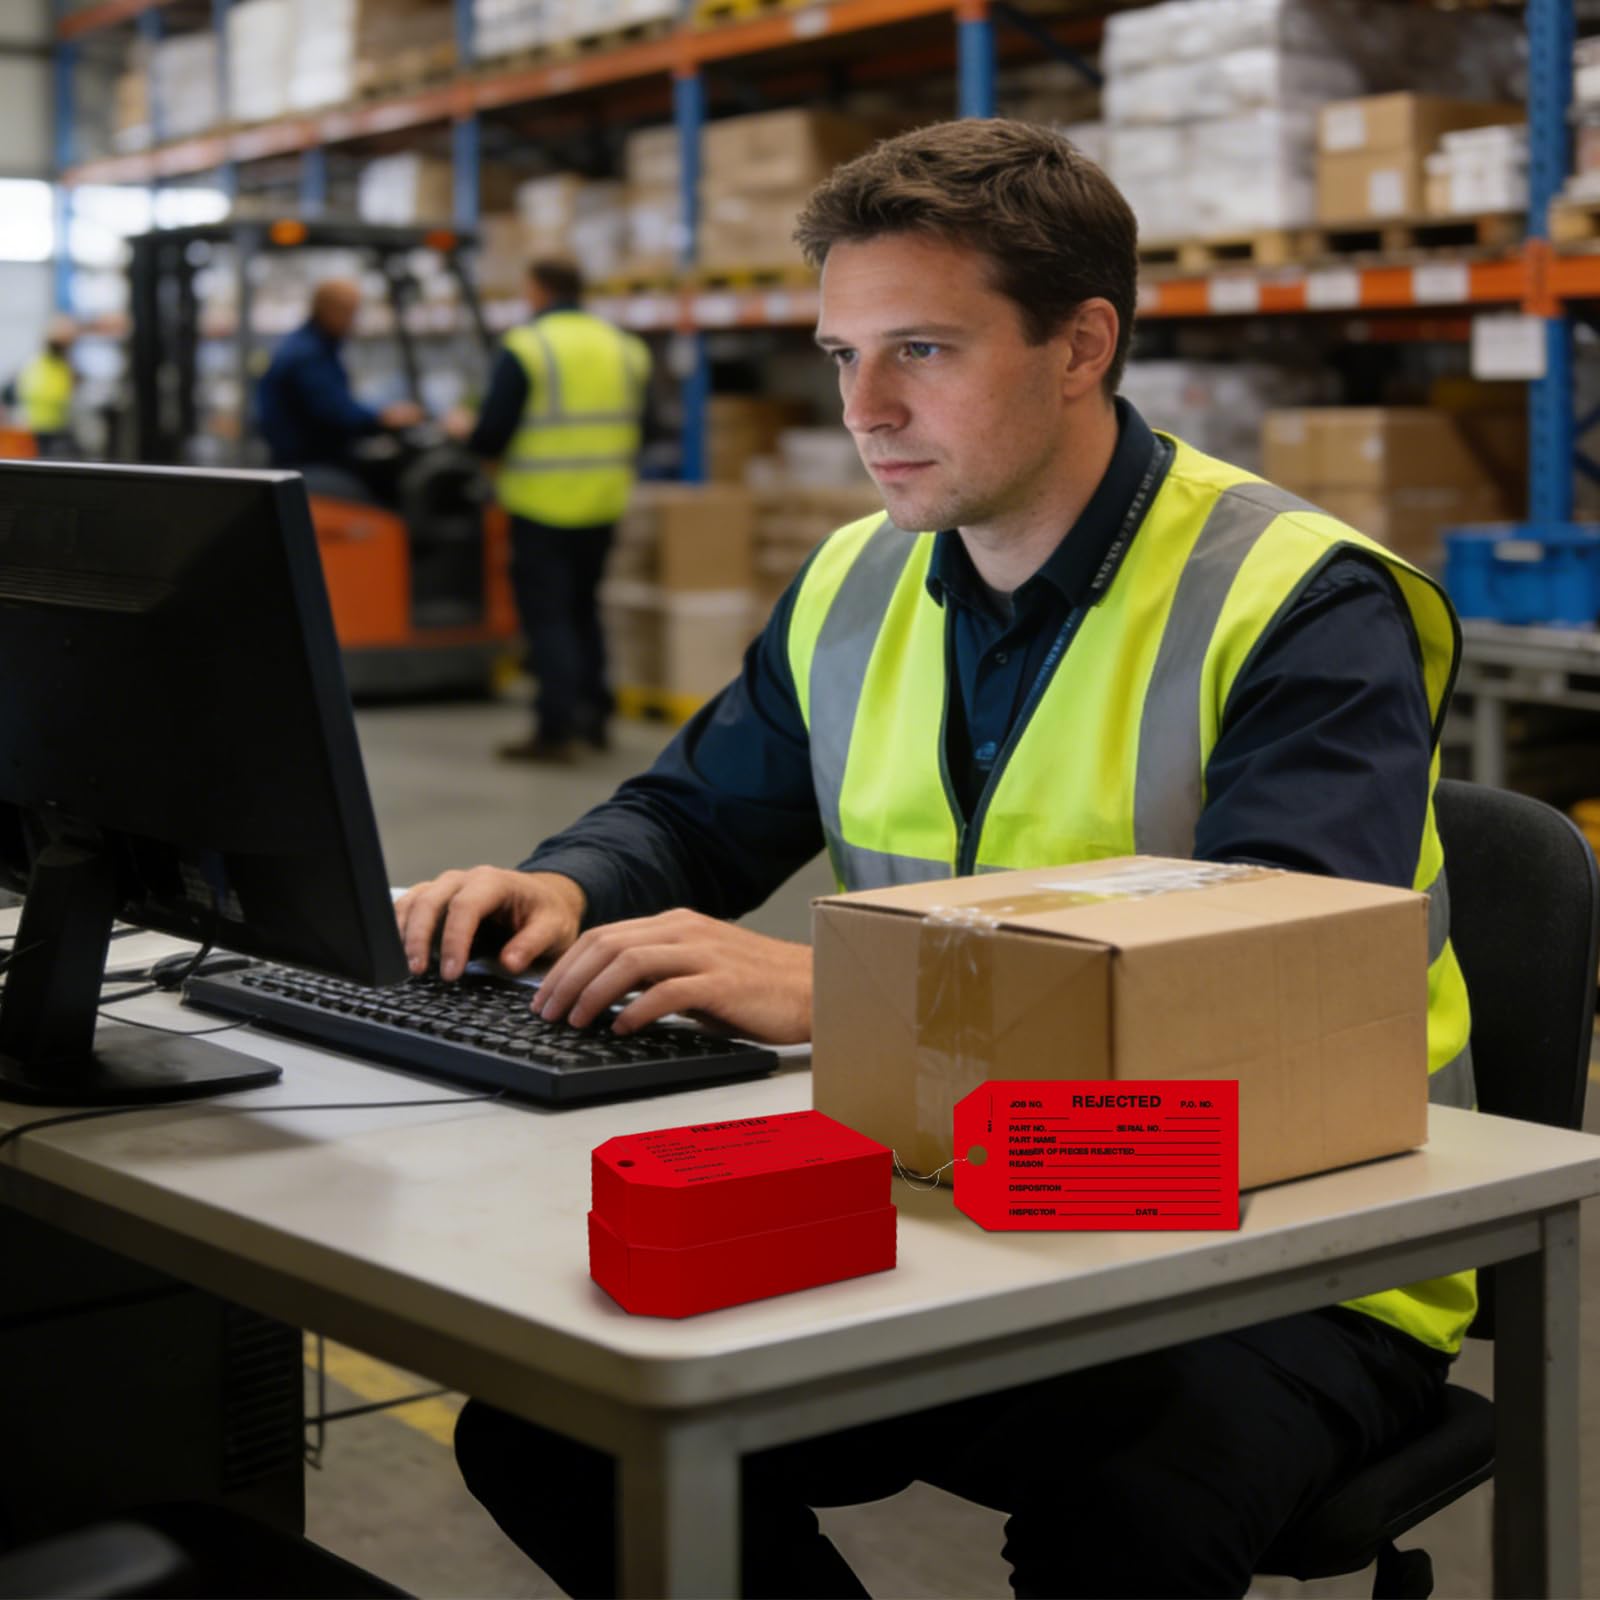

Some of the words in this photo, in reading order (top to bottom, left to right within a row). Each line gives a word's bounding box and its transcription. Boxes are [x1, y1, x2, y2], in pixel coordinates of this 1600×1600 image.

[1010, 1100, 1027, 1108] JOB
[1029, 1100, 1043, 1108] NO.
[1072, 1095, 1161, 1108] REJECTED
[1180, 1100, 1197, 1108] P.O.
[1009, 1124, 1031, 1132] PART
[1033, 1124, 1047, 1132] NO.
[1116, 1124, 1145, 1132] SERIAL
[1147, 1124, 1161, 1132] NO.
[1009, 1136, 1031, 1144] PART
[1033, 1136, 1056, 1144] NAME
[1009, 1147, 1045, 1156] NUMBER
[1046, 1147, 1058, 1155] OF
[1059, 1147, 1089, 1155] PIECES
[1091, 1147, 1135, 1155] REJECTED
[1009, 1160, 1044, 1168] REASON
[1009, 1184, 1062, 1192] DISPOSITION
[1009, 1208, 1056, 1216] INSPECTOR
[1135, 1208, 1158, 1216] DATE
